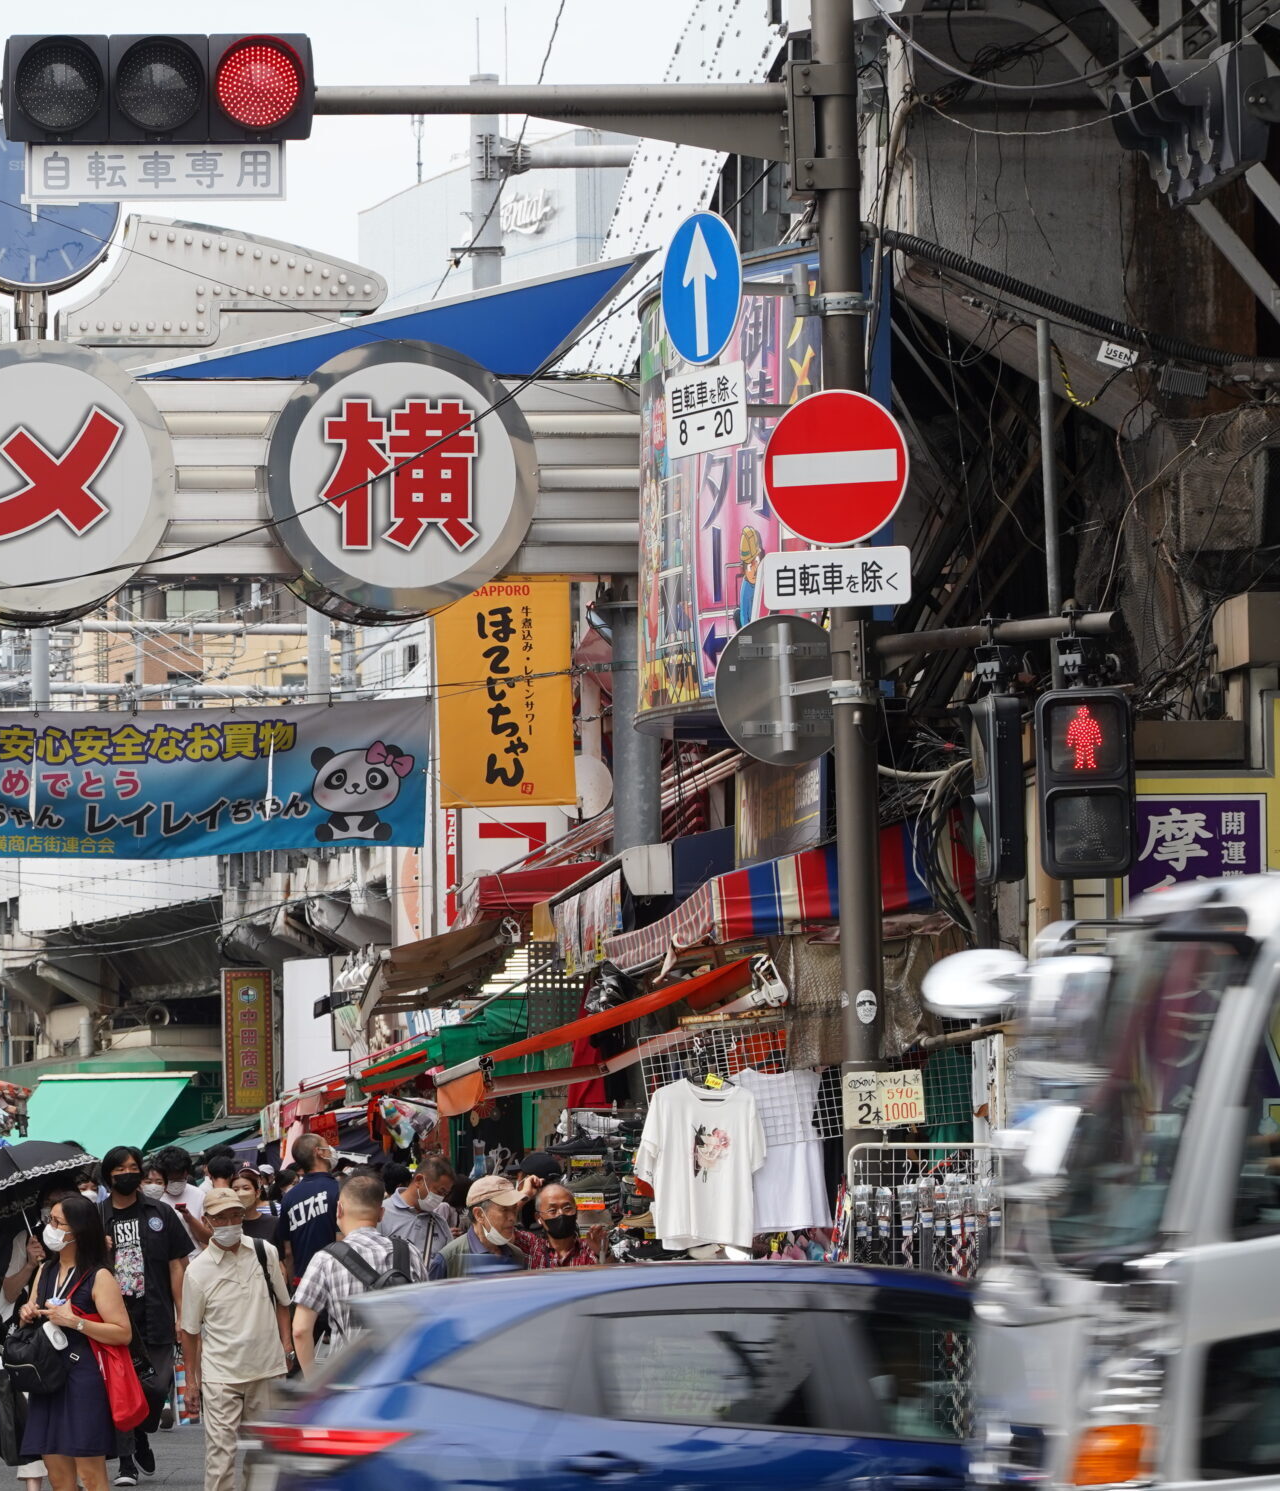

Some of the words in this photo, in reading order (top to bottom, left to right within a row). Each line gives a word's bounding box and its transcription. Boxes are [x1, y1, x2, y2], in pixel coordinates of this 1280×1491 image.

[42, 149, 272, 190] 自転車専用
[1105, 348, 1132, 362] USEN
[671, 375, 739, 414] 自転車を除く
[472, 584, 531, 597] SAPPORO
[775, 561, 899, 597] 自転車を除く
[476, 606, 529, 788] ほていちゃん
[84, 791, 312, 837] レイレイちゃん
[239, 1007, 258, 1088] 中田商店
